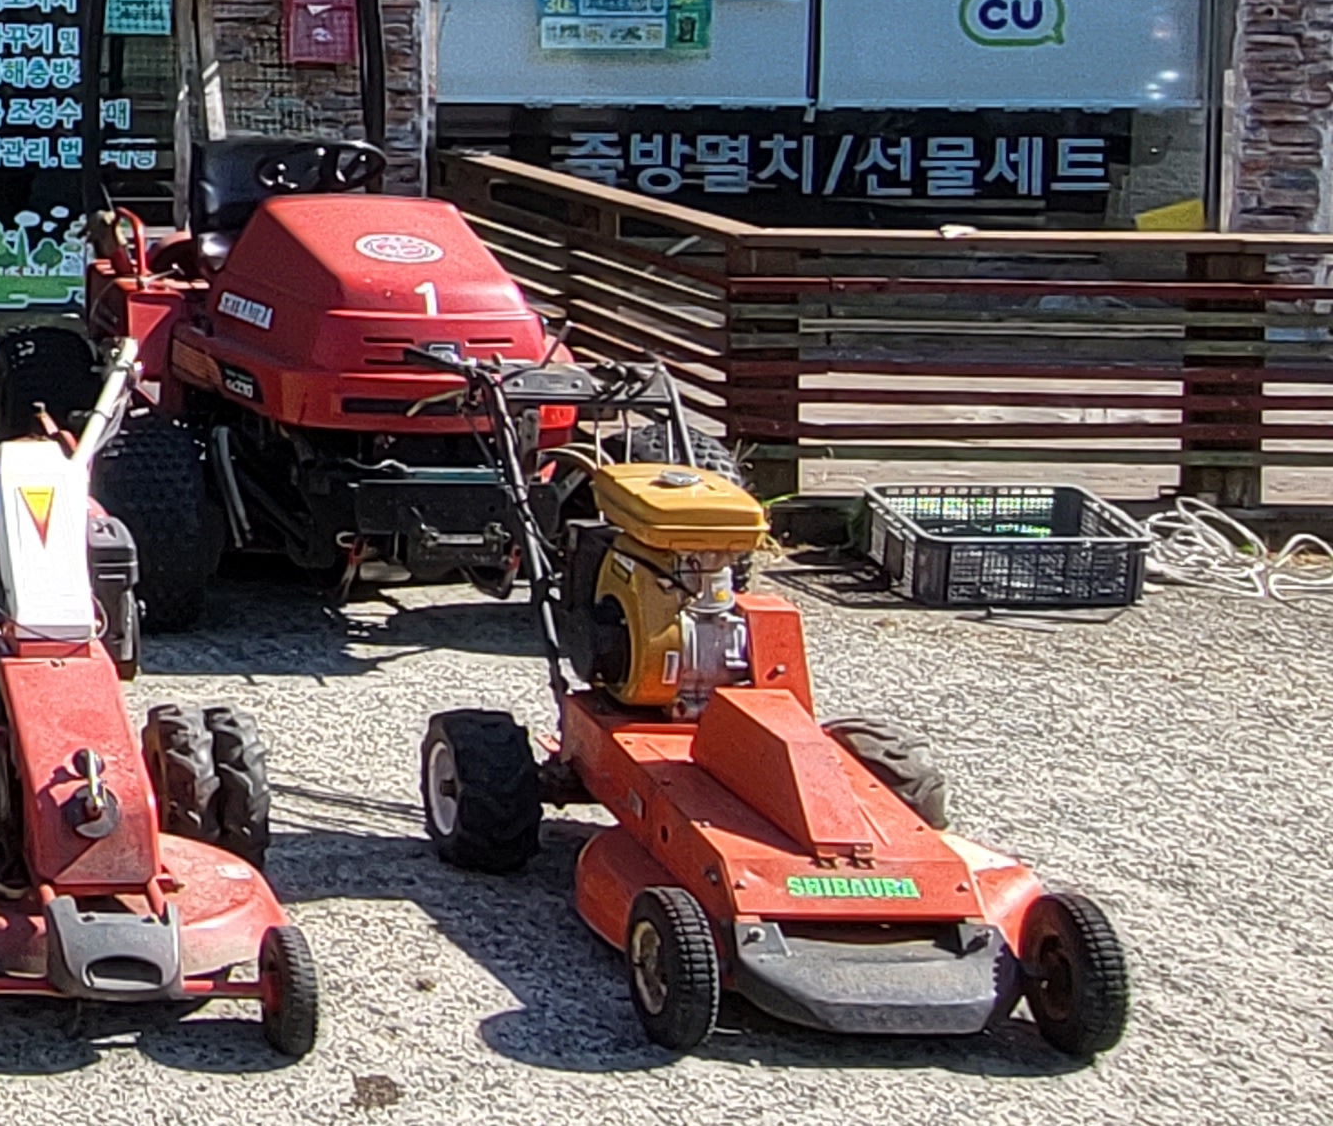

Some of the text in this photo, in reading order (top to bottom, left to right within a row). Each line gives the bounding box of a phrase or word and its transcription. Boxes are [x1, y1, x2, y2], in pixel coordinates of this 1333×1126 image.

[58, 27, 80, 55] 및
[6, 97, 82, 129] 조경수
[414, 281, 438, 317] 1
[786, 876, 922, 899] SHIBAURA
